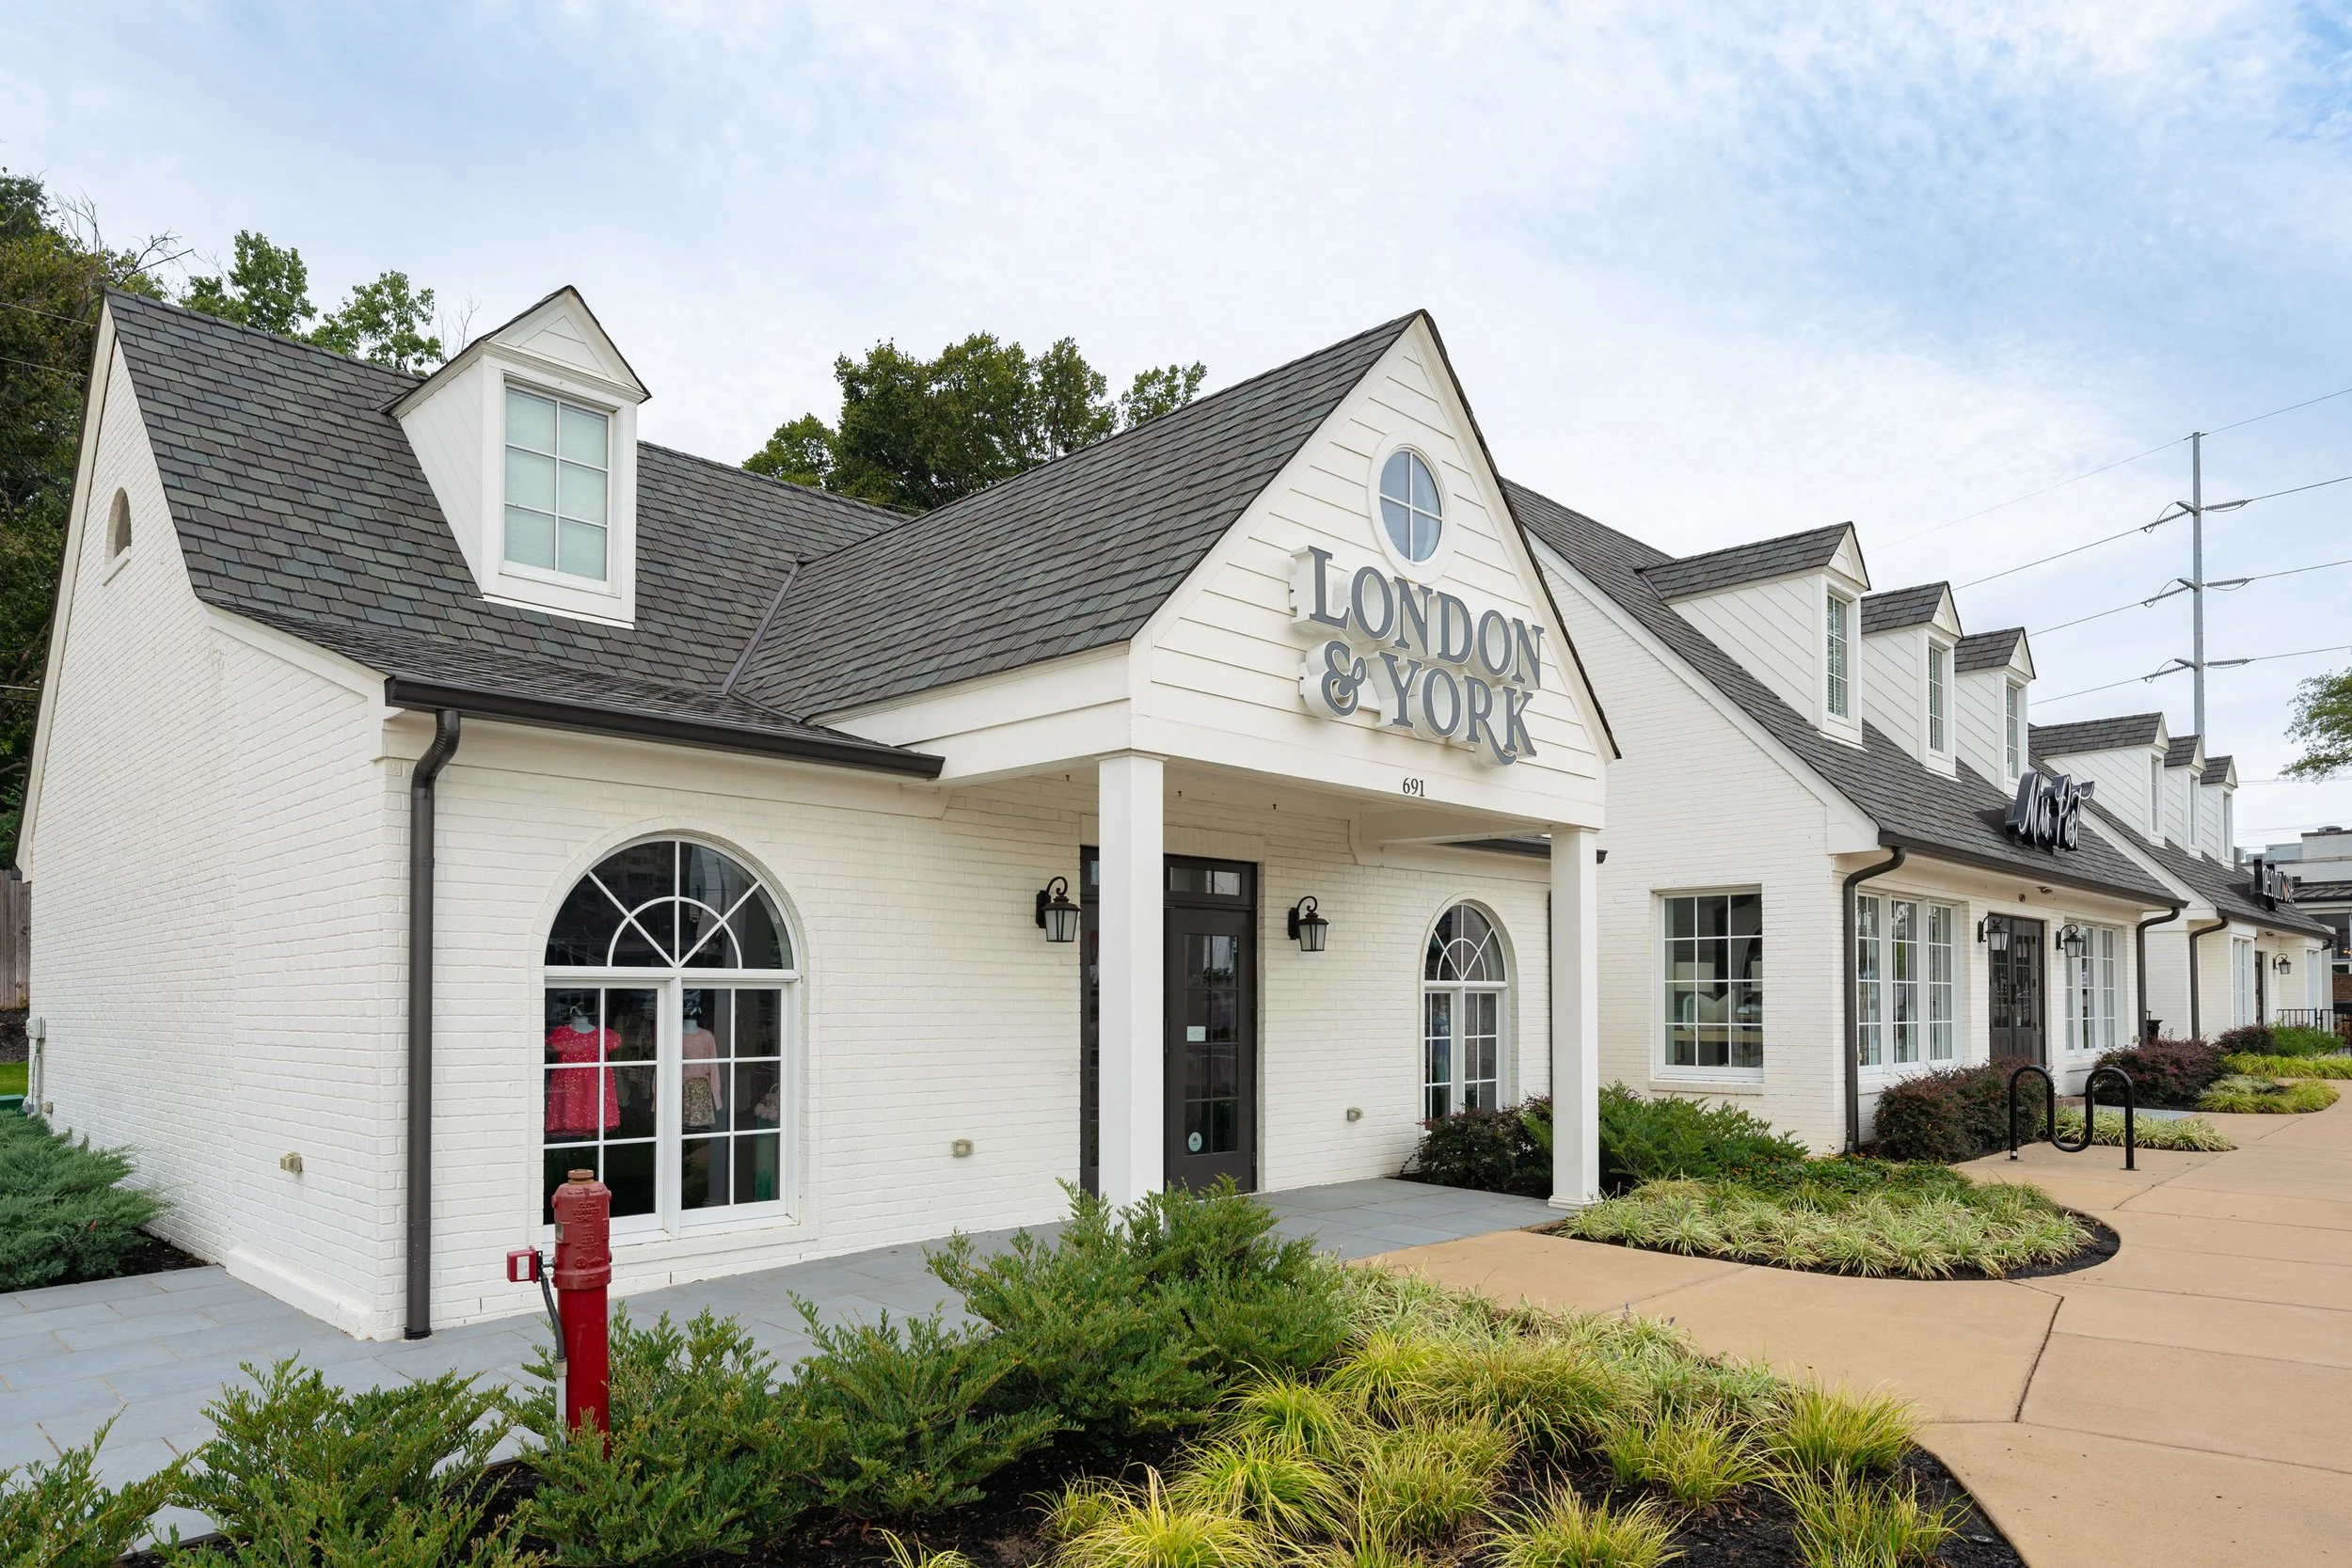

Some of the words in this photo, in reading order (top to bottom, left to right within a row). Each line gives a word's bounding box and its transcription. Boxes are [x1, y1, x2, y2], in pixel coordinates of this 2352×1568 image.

[1307, 545, 1545, 690] LONDON
[1321, 640, 1367, 718] &
[1378, 650, 1538, 767] YORK
[1402, 777, 1425, 798] 691
